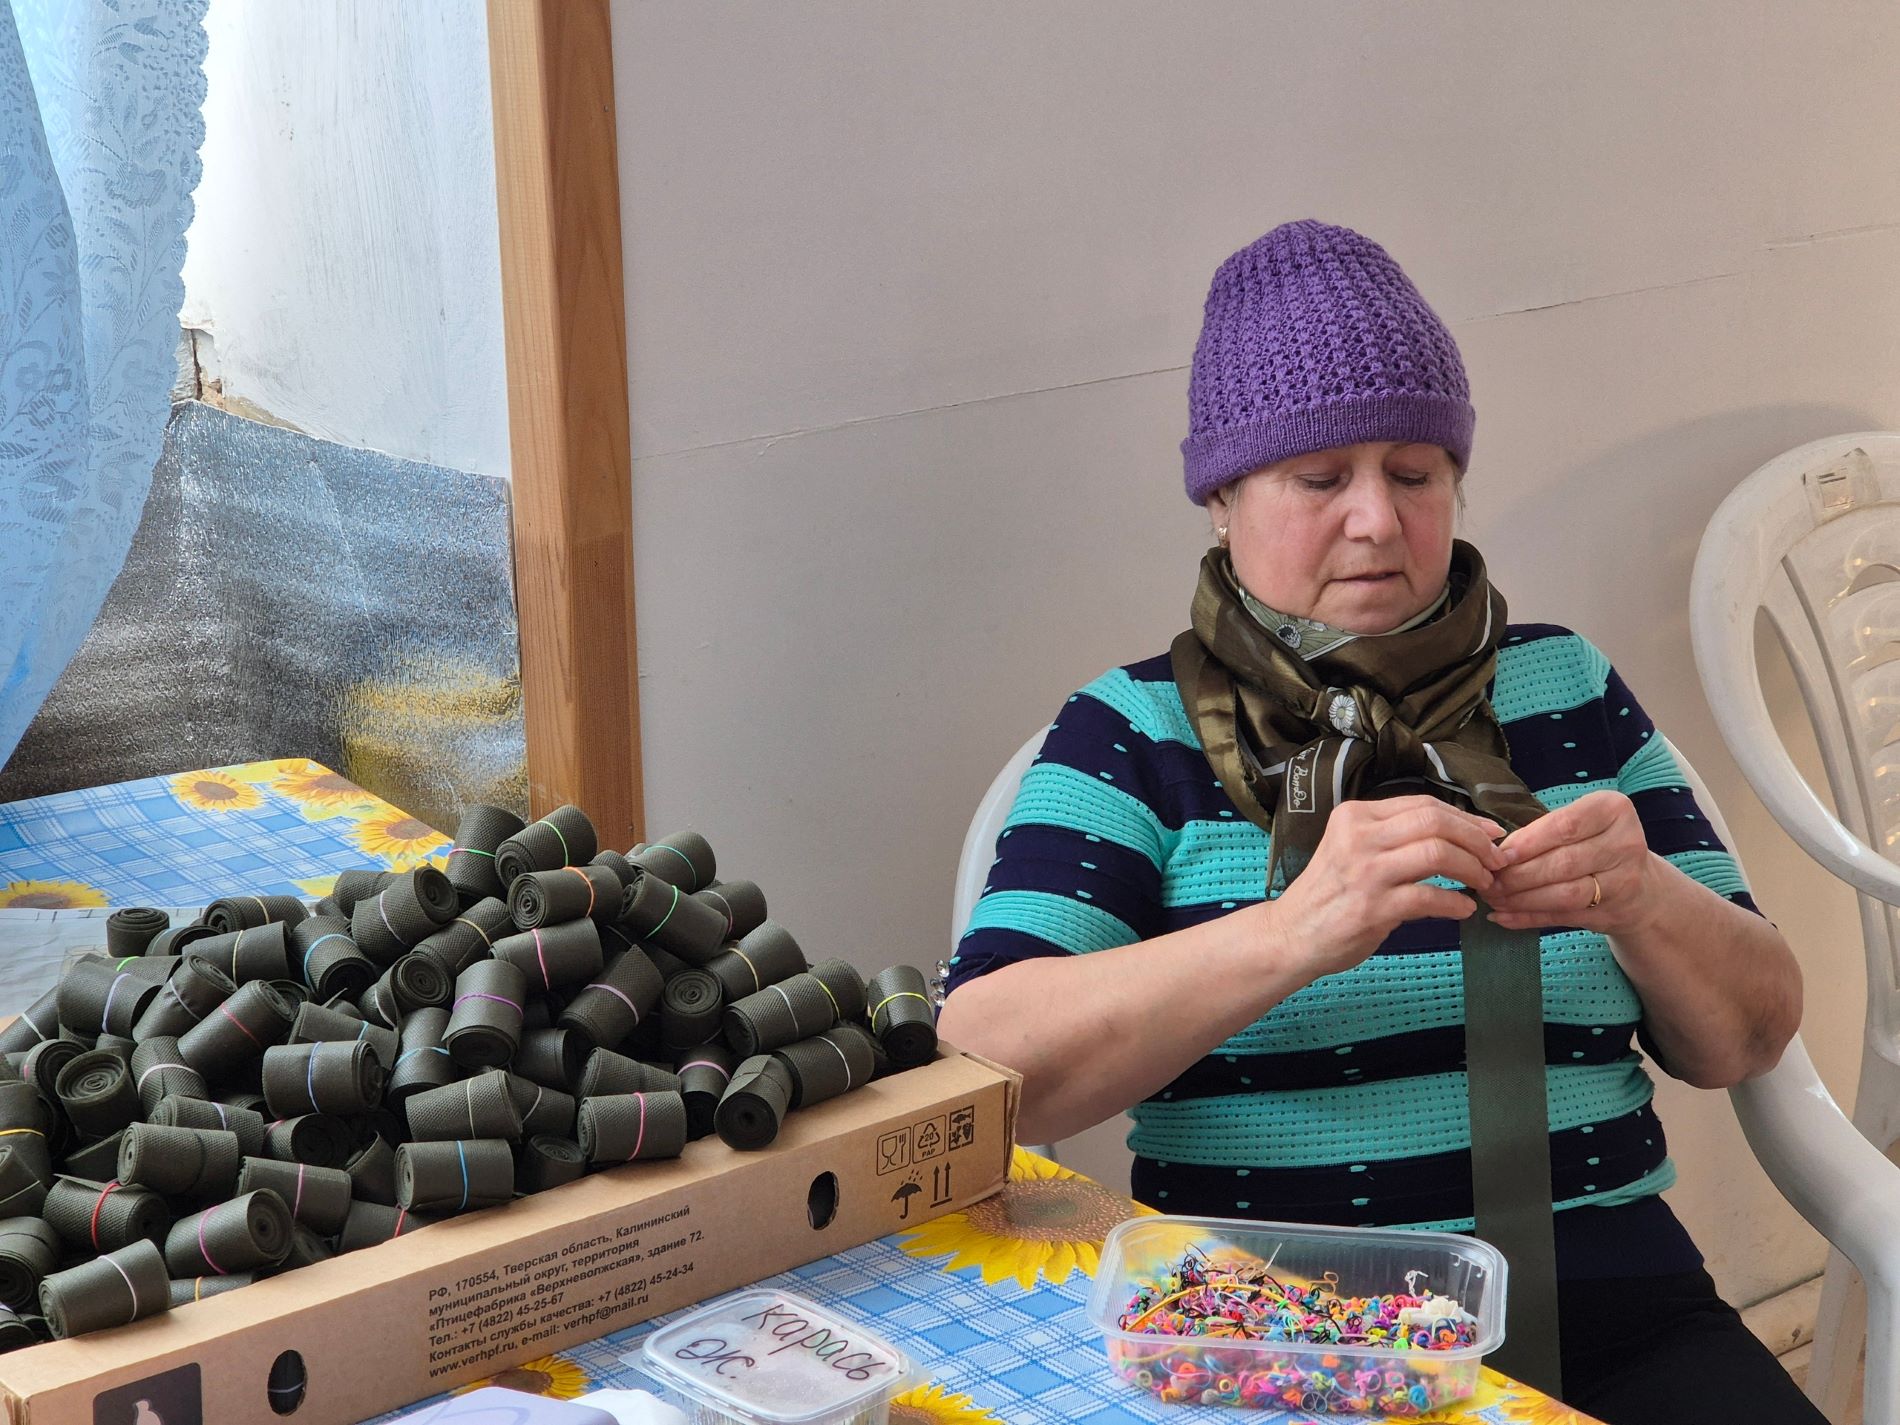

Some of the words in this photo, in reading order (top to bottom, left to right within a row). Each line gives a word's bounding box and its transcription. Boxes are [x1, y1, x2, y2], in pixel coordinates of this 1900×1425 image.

[922, 1149, 936, 1158] PAP
[925, 1132, 934, 1142] 20
[429, 1287, 451, 1301] РФ,
[455, 1269, 499, 1292] 170554,
[503, 1252, 558, 1276] Тверская
[561, 1235, 613, 1257] область,
[616, 1205, 690, 1238] Калининский
[429, 1274, 531, 1317] муниципальный
[533, 1263, 568, 1283] округ,
[571, 1239, 640, 1268] территория
[429, 1293, 527, 1332] «Птицефабрика
[530, 1253, 645, 1297] «Верхневолжская»,
[647, 1238, 687, 1258] здание
[689, 1230, 705, 1244] 72.
[429, 1336, 487, 1363] Контакты
[490, 1317, 537, 1340] службы
[540, 1299, 595, 1324] качества:
[598, 1290, 612, 1304] +7
[614, 1278, 647, 1301] (4822)
[649, 1261, 694, 1286] 45-24-34
[429, 1330, 459, 1347] Тел.:
[461, 1322, 476, 1335] +7
[478, 1310, 514, 1334] (4822)
[516, 1292, 564, 1317] 45-25-67
[429, 1341, 518, 1378] www.verhpf.ru,
[521, 1324, 560, 1346] e-mail:
[563, 1294, 649, 1330] verhpf@mail.ru
